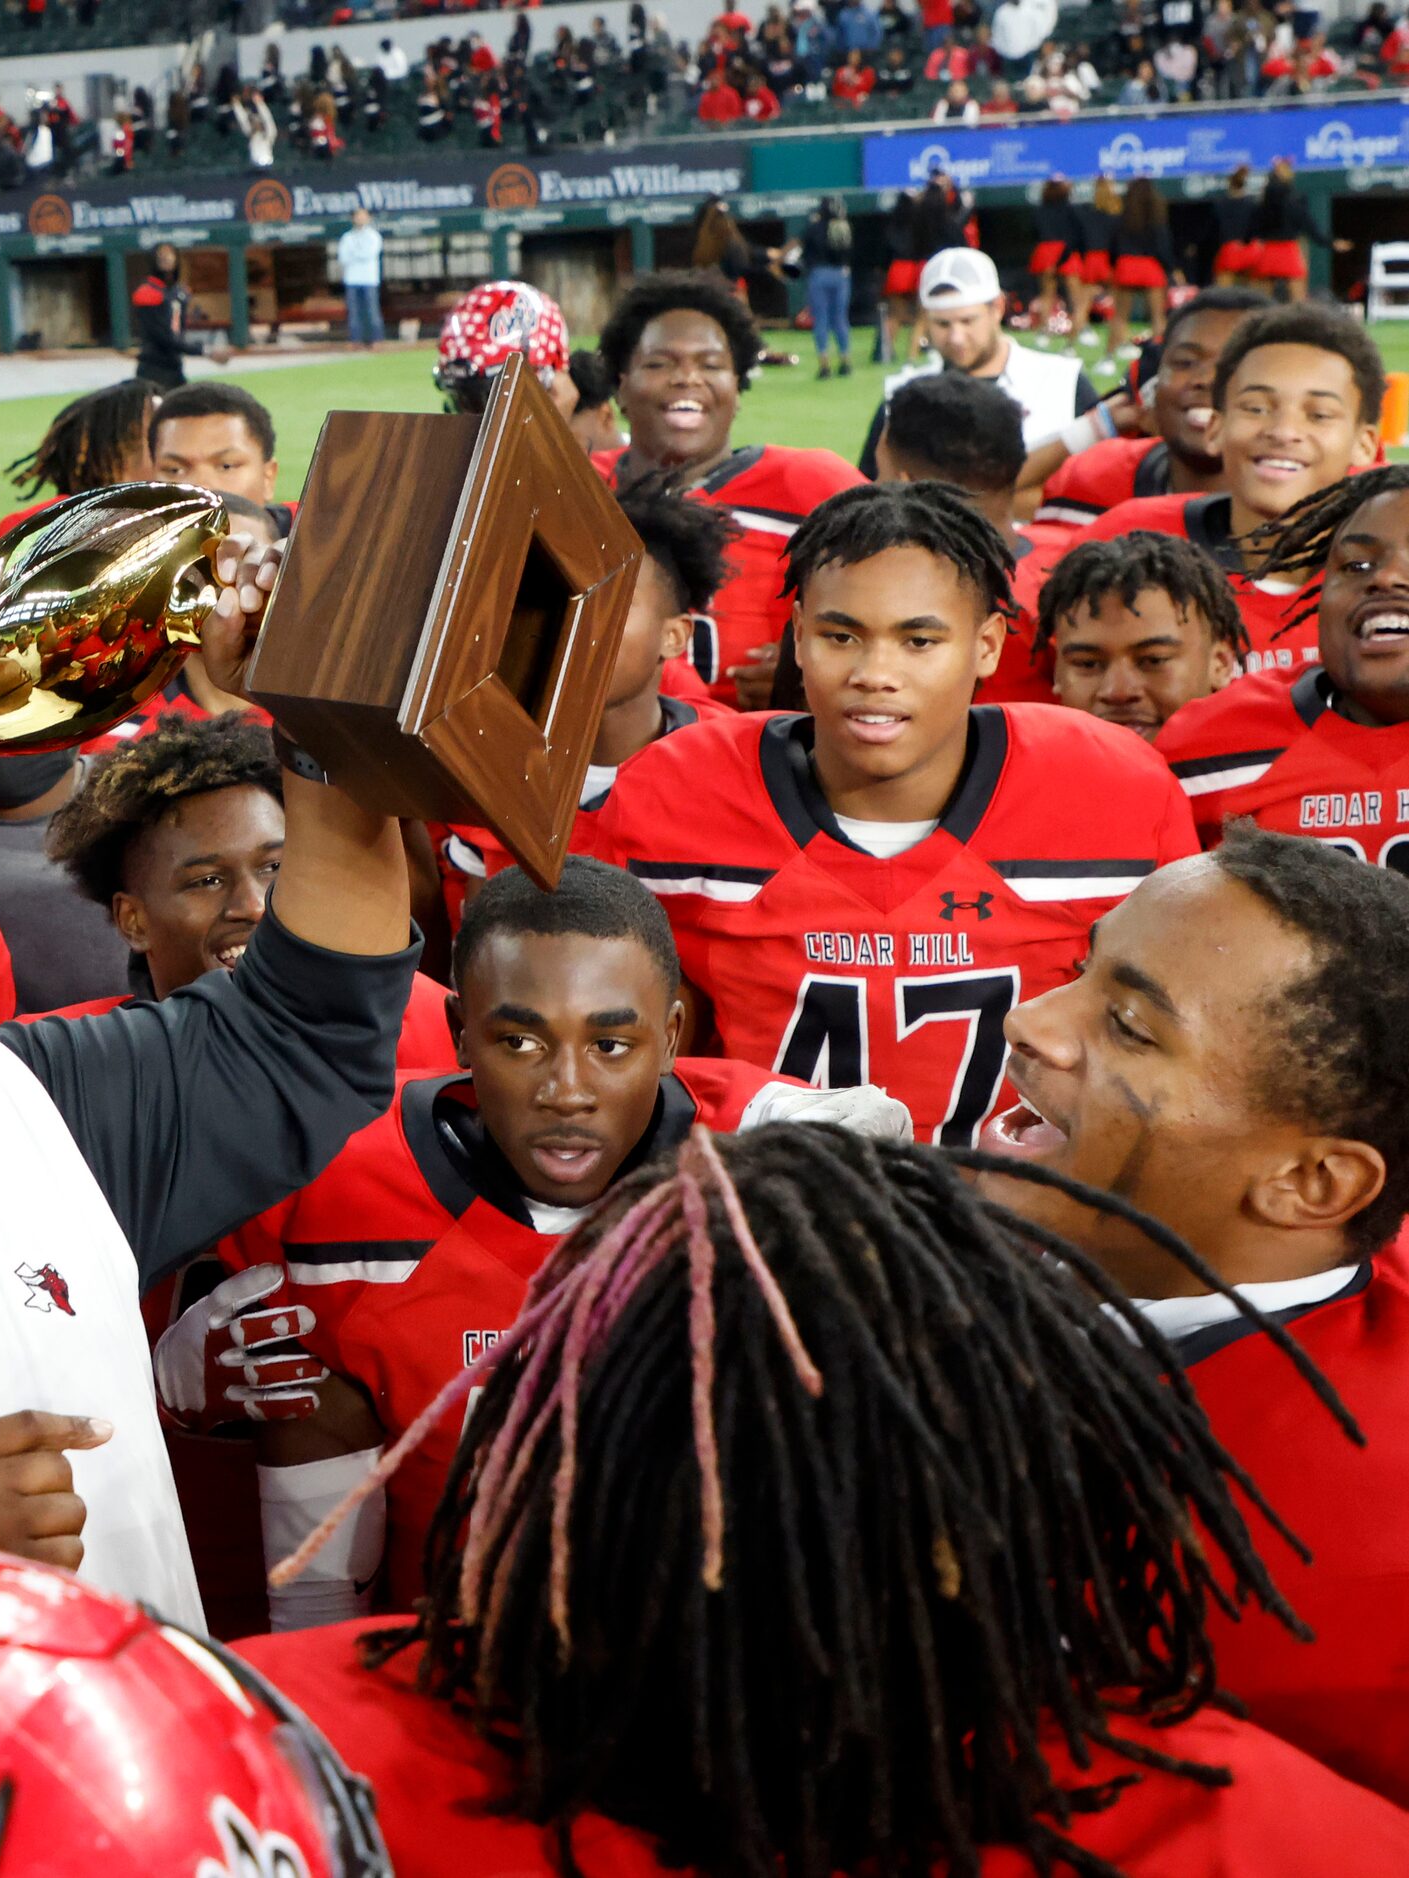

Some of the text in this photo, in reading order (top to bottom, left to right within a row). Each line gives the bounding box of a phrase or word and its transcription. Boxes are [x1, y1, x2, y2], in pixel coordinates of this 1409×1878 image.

[293, 179, 474, 216] Evan Williams
[539, 163, 742, 201] Evan Williams
[1299, 791, 1382, 828] CEDAR
[804, 932, 974, 966] CEDAR HILL
[771, 965, 1022, 1150] 47
